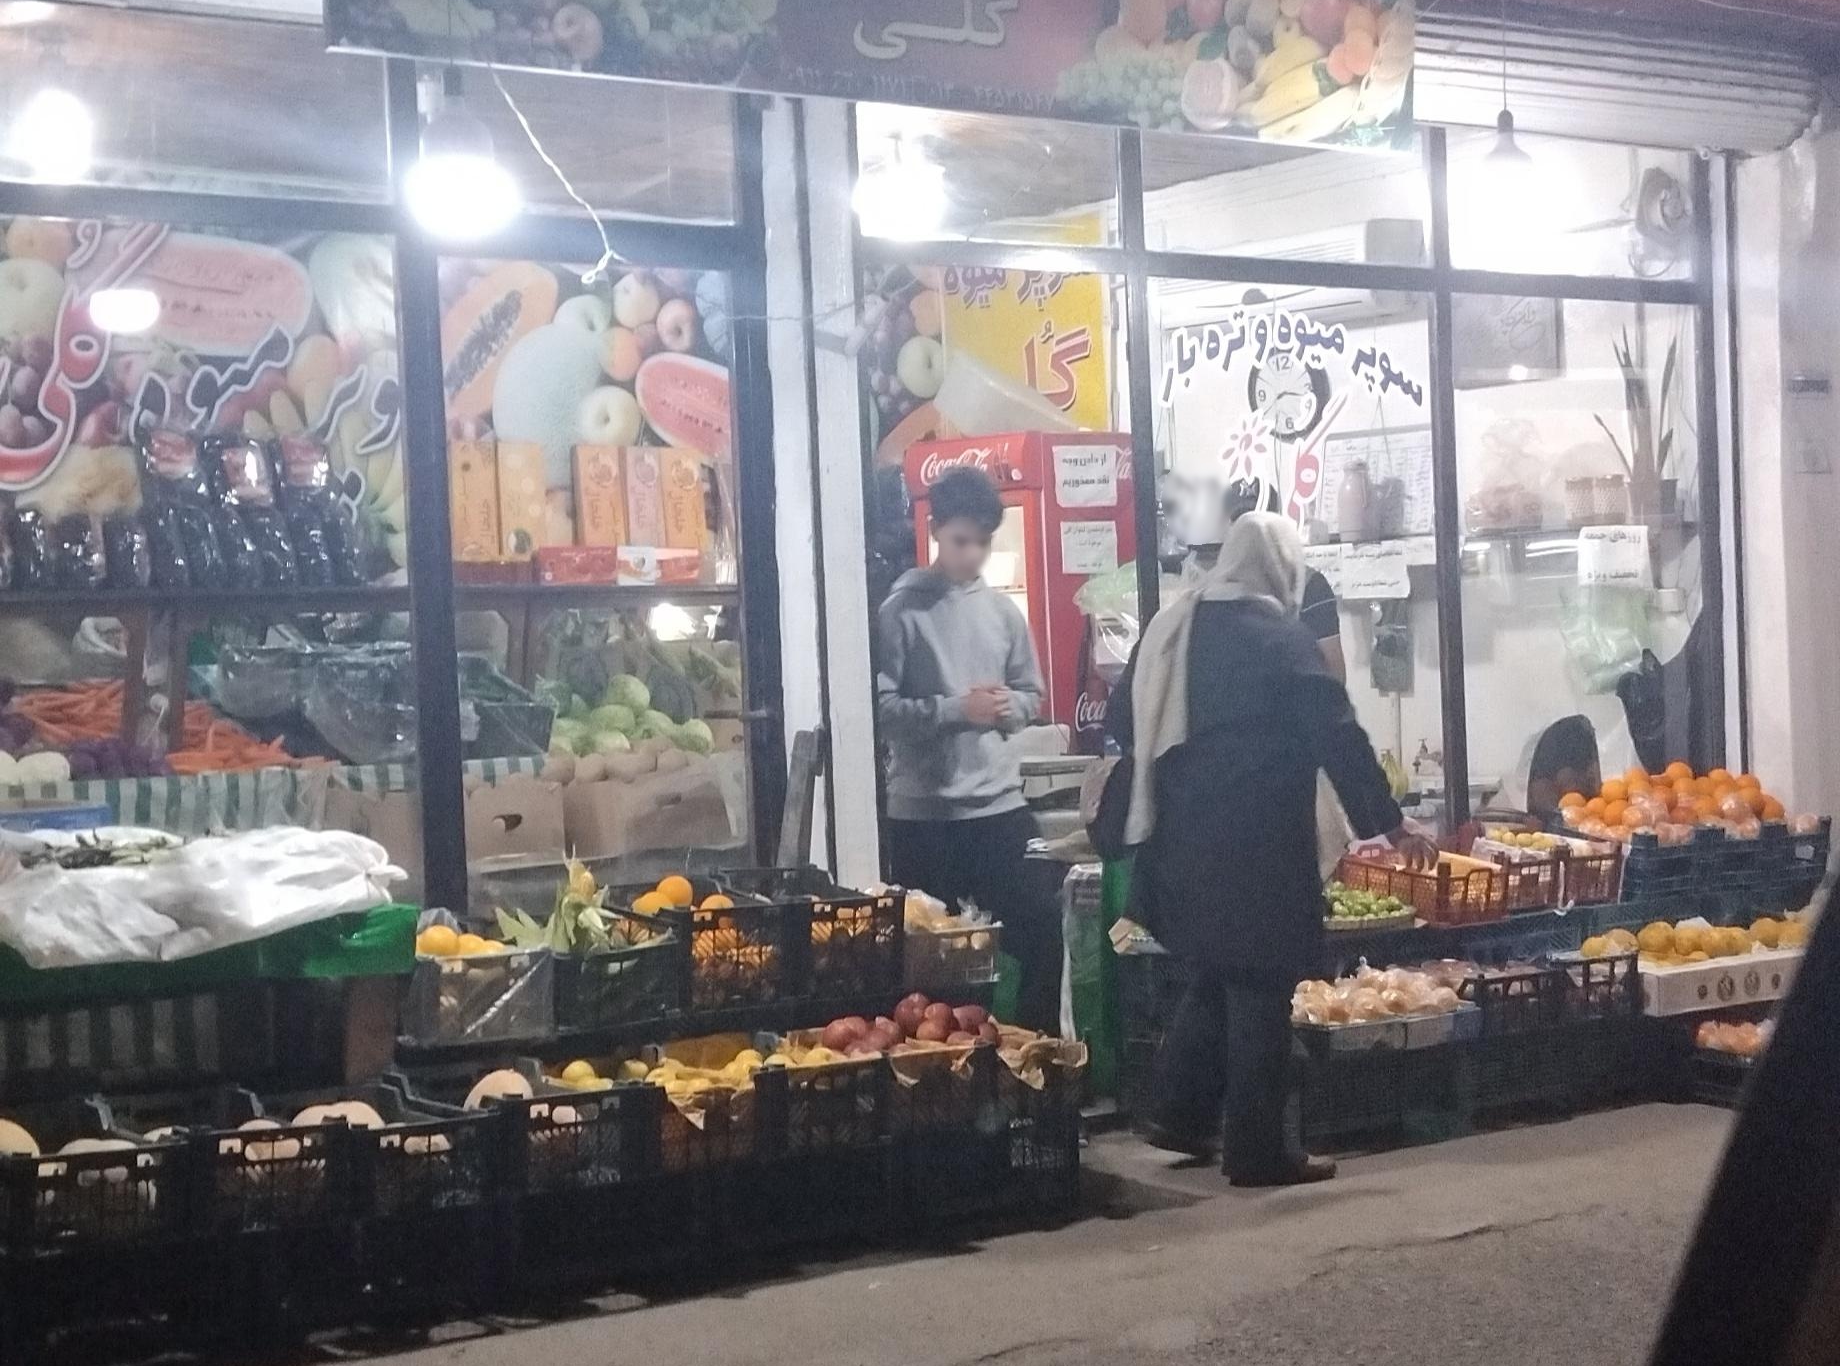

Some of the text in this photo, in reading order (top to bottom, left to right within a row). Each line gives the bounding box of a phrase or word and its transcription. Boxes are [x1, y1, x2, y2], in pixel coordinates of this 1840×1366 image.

[1161, 332, 1196, 403] بار
[1204, 309, 1246, 372] تره
[1277, 313, 1345, 363] میوه
[1350, 345, 1423, 408] سوپر
